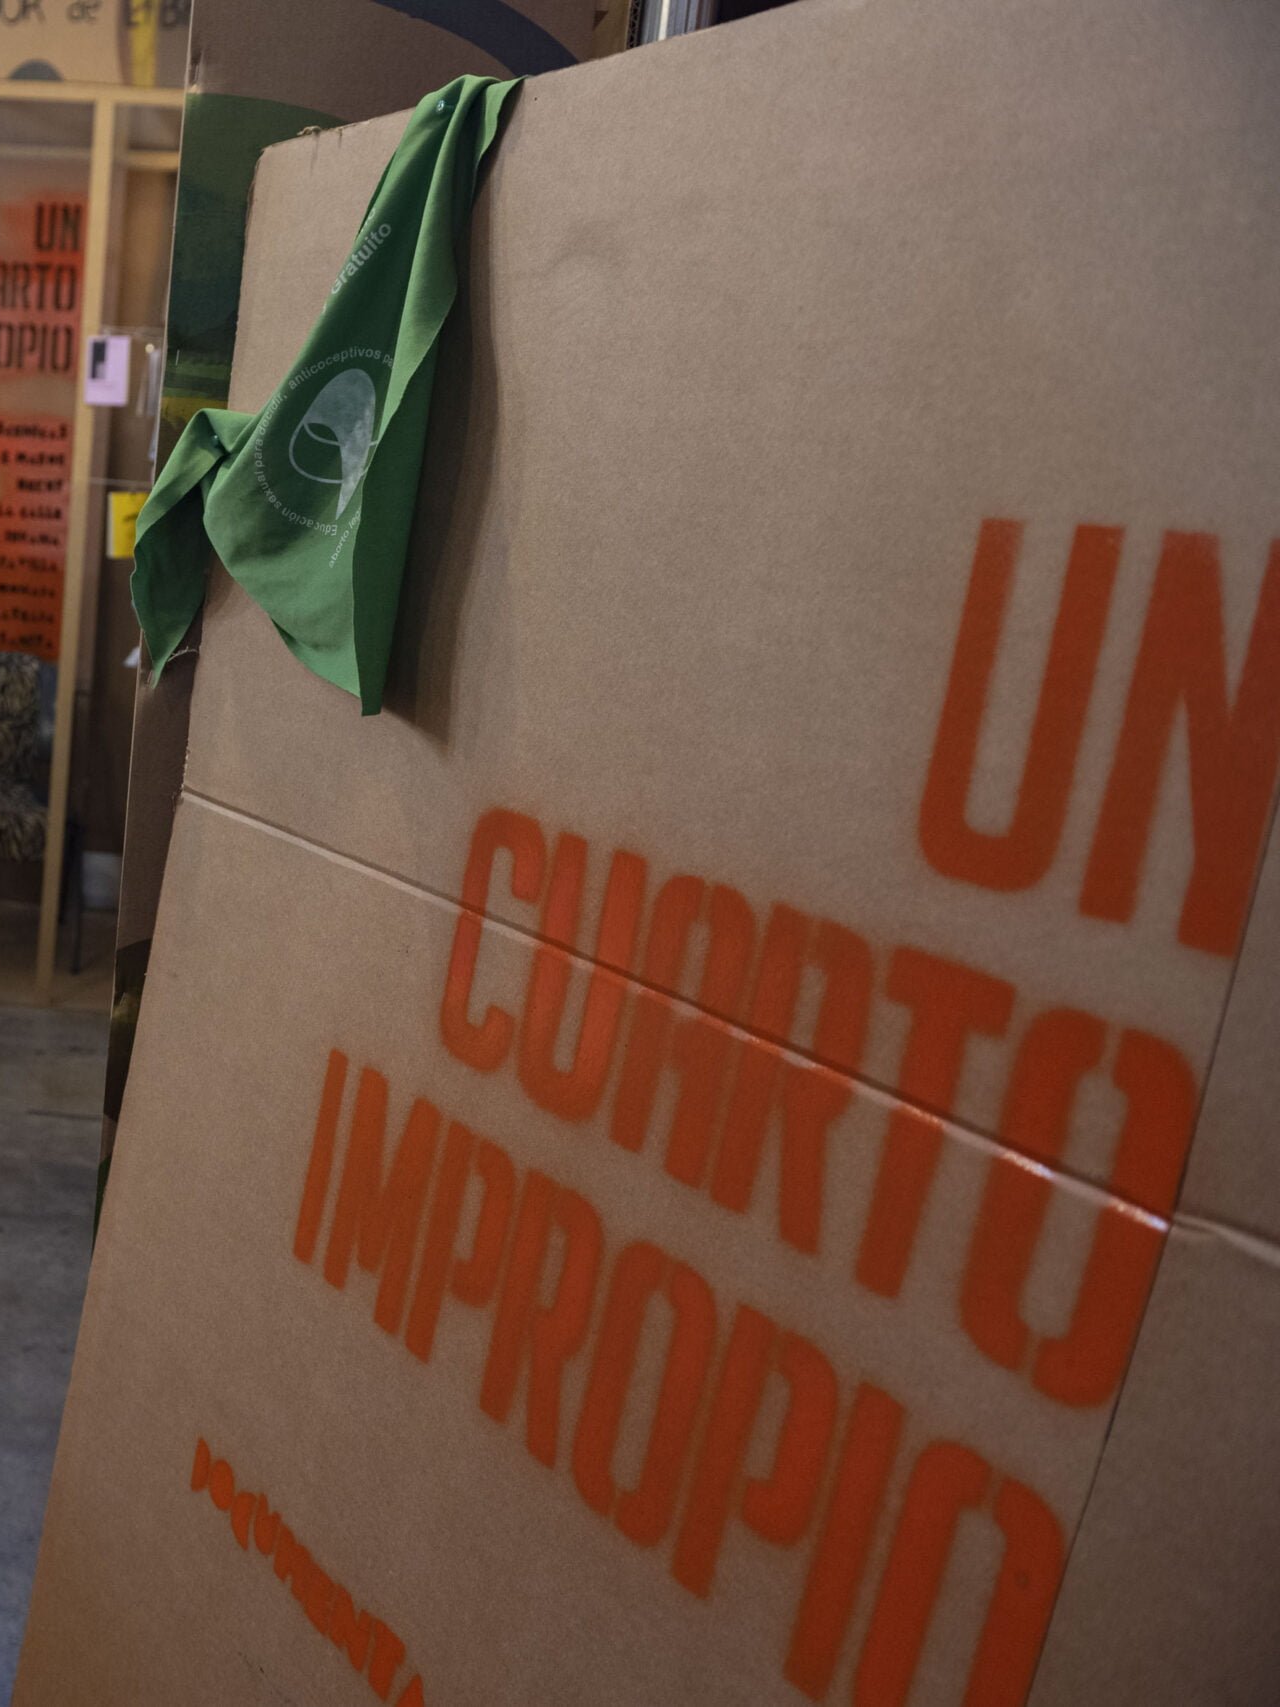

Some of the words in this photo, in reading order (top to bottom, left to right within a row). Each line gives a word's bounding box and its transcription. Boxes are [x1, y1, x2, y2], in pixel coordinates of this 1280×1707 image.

[35, 202, 83, 253] UN
[331, 223, 392, 294] Gratuito
[254, 438, 264, 468] para
[328, 529, 350, 569] aborto
[920, 521, 1280, 959] UN
[440, 807, 1200, 1409] CUARTO
[293, 1049, 1066, 1707] IMPROPIO
